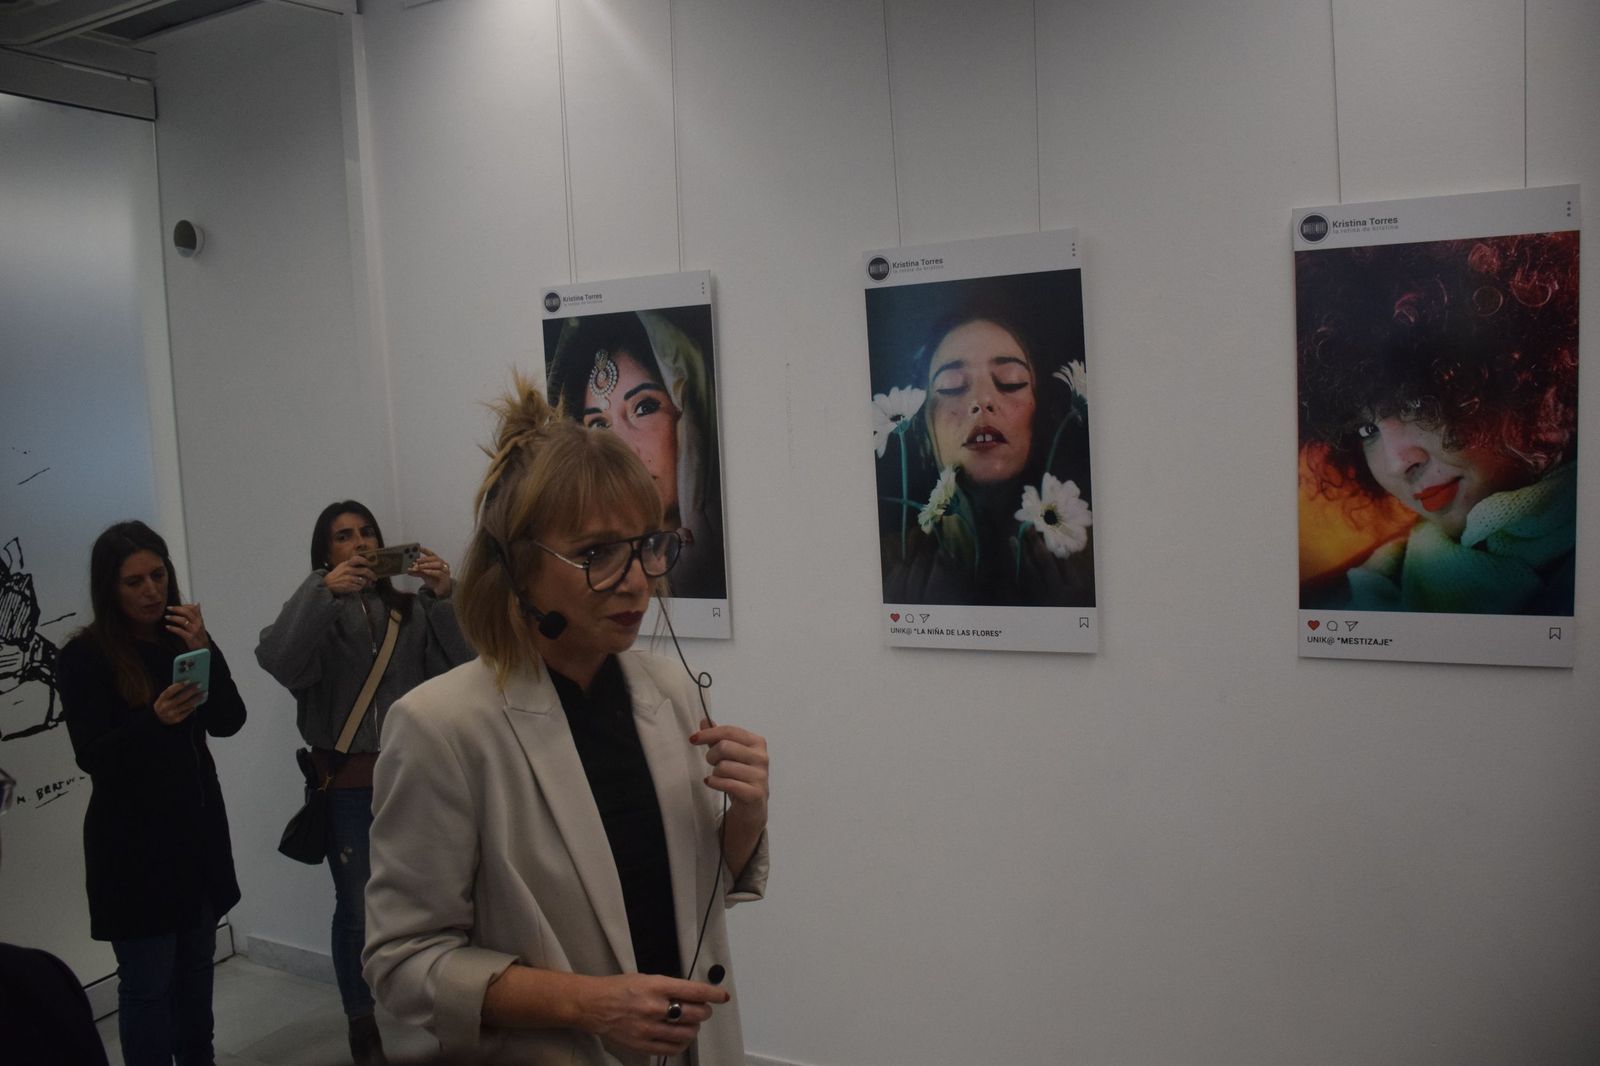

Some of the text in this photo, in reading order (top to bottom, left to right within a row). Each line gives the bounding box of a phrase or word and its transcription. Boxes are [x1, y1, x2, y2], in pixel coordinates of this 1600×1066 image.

[1332, 219, 1367, 228] Kristina
[1369, 217, 1399, 225] Torres
[892, 260, 919, 269] Kristina
[890, 627, 912, 635] UNIK@
[927, 627, 945, 635] NIÑA
[1307, 636, 1335, 645] UNIK@
